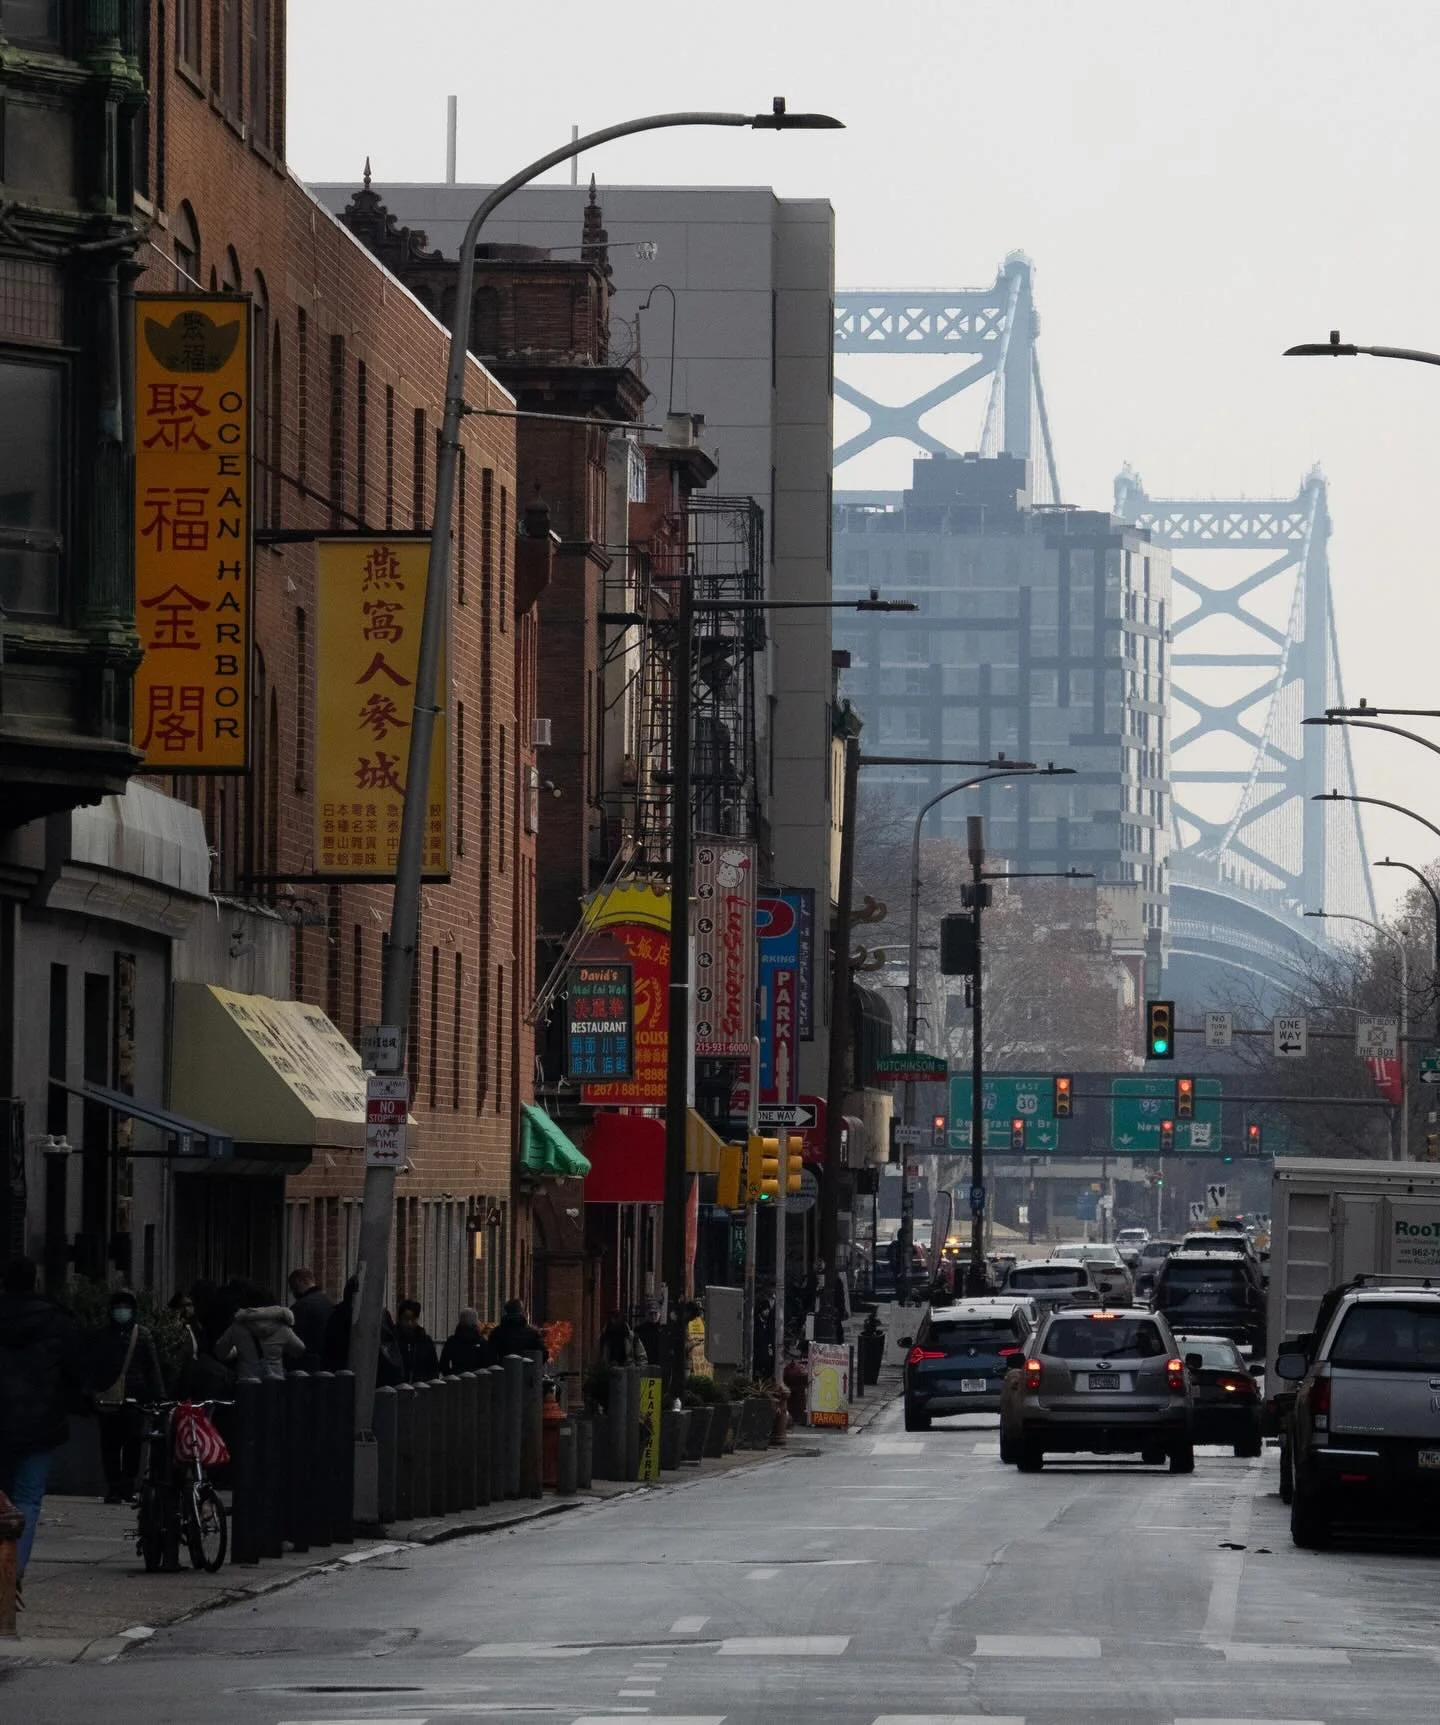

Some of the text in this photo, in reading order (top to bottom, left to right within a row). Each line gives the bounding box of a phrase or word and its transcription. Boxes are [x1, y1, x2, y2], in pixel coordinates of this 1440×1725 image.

[140, 383, 212, 753] 聚福金閣
[214, 391, 242, 739] OCEAN HARBOR
[580, 970, 618, 981] David's
[571, 1022, 627, 1033] RESTAURANT
[1279, 1020, 1301, 1030] ONE
[1279, 1031, 1301, 1041] WAY
[876, 1060, 935, 1071] HUTCHINSON
[380, 1101, 395, 1114] NO
[1142, 1100, 1159, 1112] 95
[368, 1113, 406, 1123] STOPPING
[777, 1111, 796, 1121] WAY
[814, 1412, 846, 1424] PARKING
